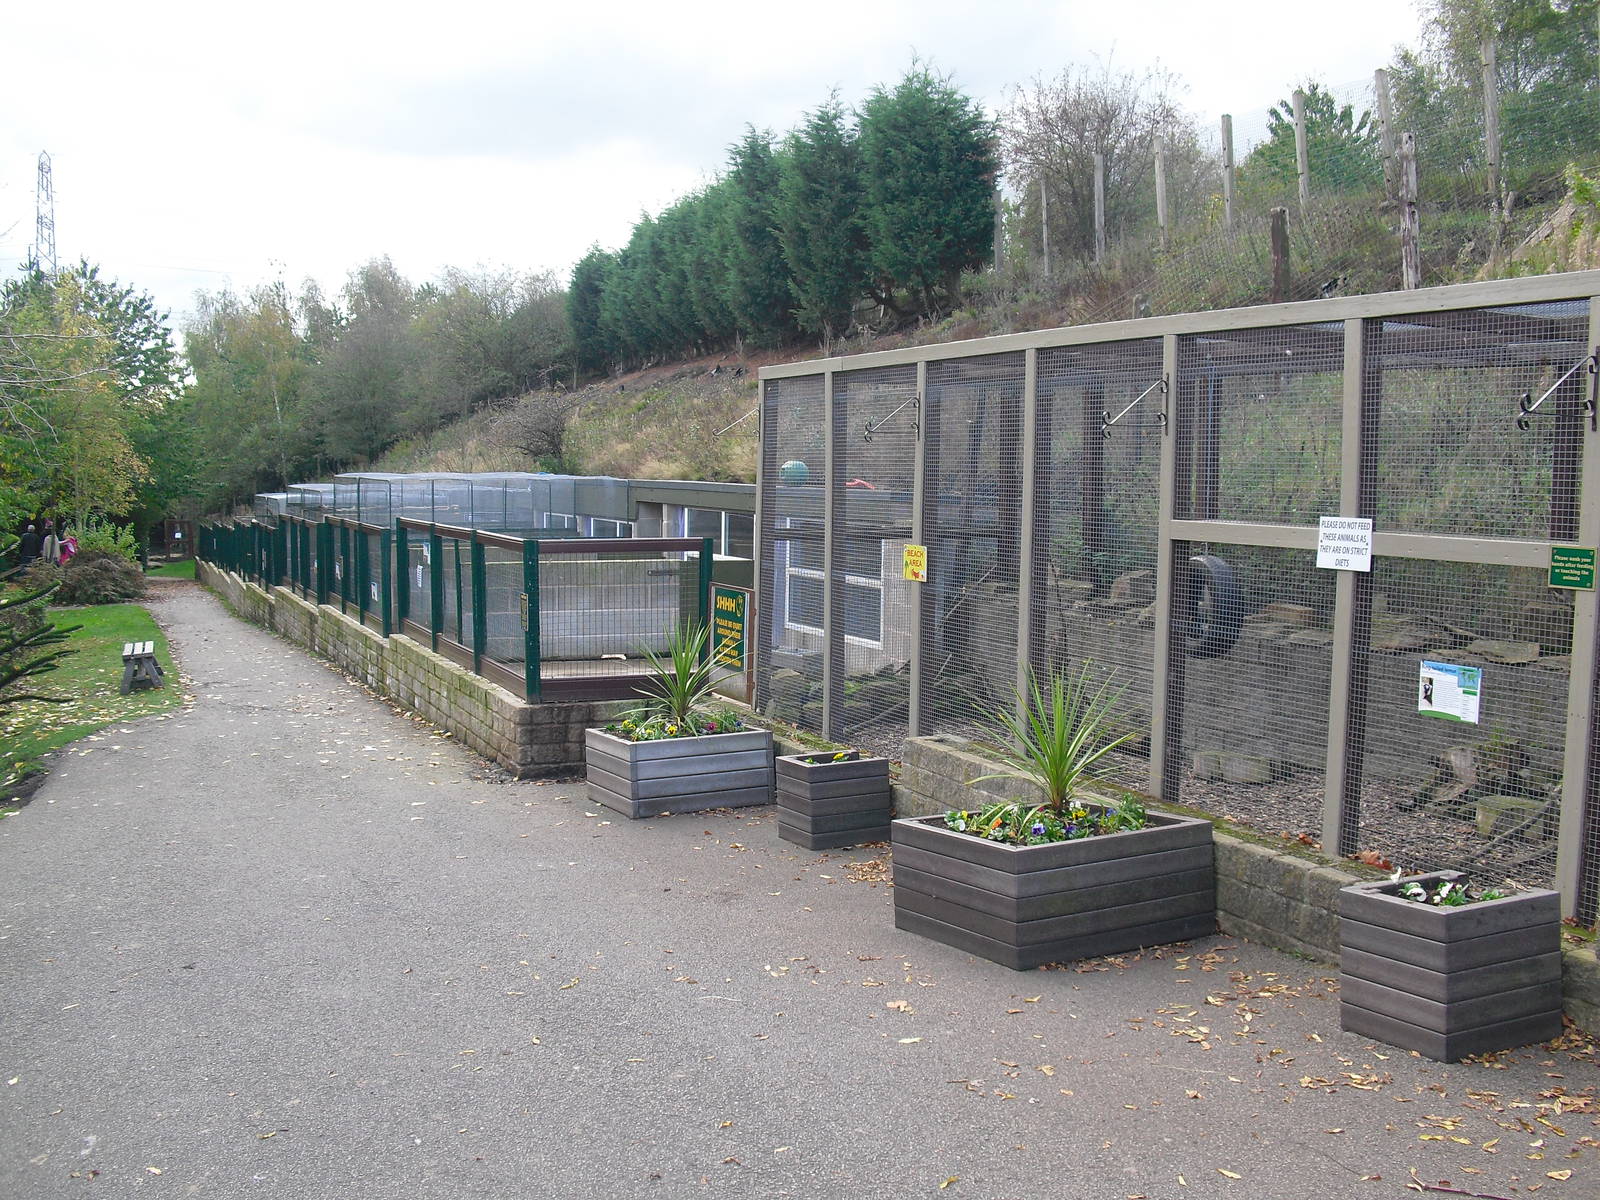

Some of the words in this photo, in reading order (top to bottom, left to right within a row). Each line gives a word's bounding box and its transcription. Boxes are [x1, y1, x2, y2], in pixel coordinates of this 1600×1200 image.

[1321, 520, 1338, 529] PLEASE
[1339, 521, 1346, 530] DO
[1347, 522, 1358, 530] NOT
[1358, 522, 1370, 530] FEED
[1322, 532, 1337, 541] THESE
[1337, 534, 1360, 542] ANIMALS
[907, 550, 923, 558] BEACH
[1320, 545, 1332, 553] THEY
[1332, 546, 1342, 554] ARE
[1342, 546, 1350, 554] ON
[1350, 547, 1368, 556] STRICT
[910, 559, 922, 567] AREA
[1335, 558, 1349, 567] DIETS
[716, 595, 736, 612] SHHH
